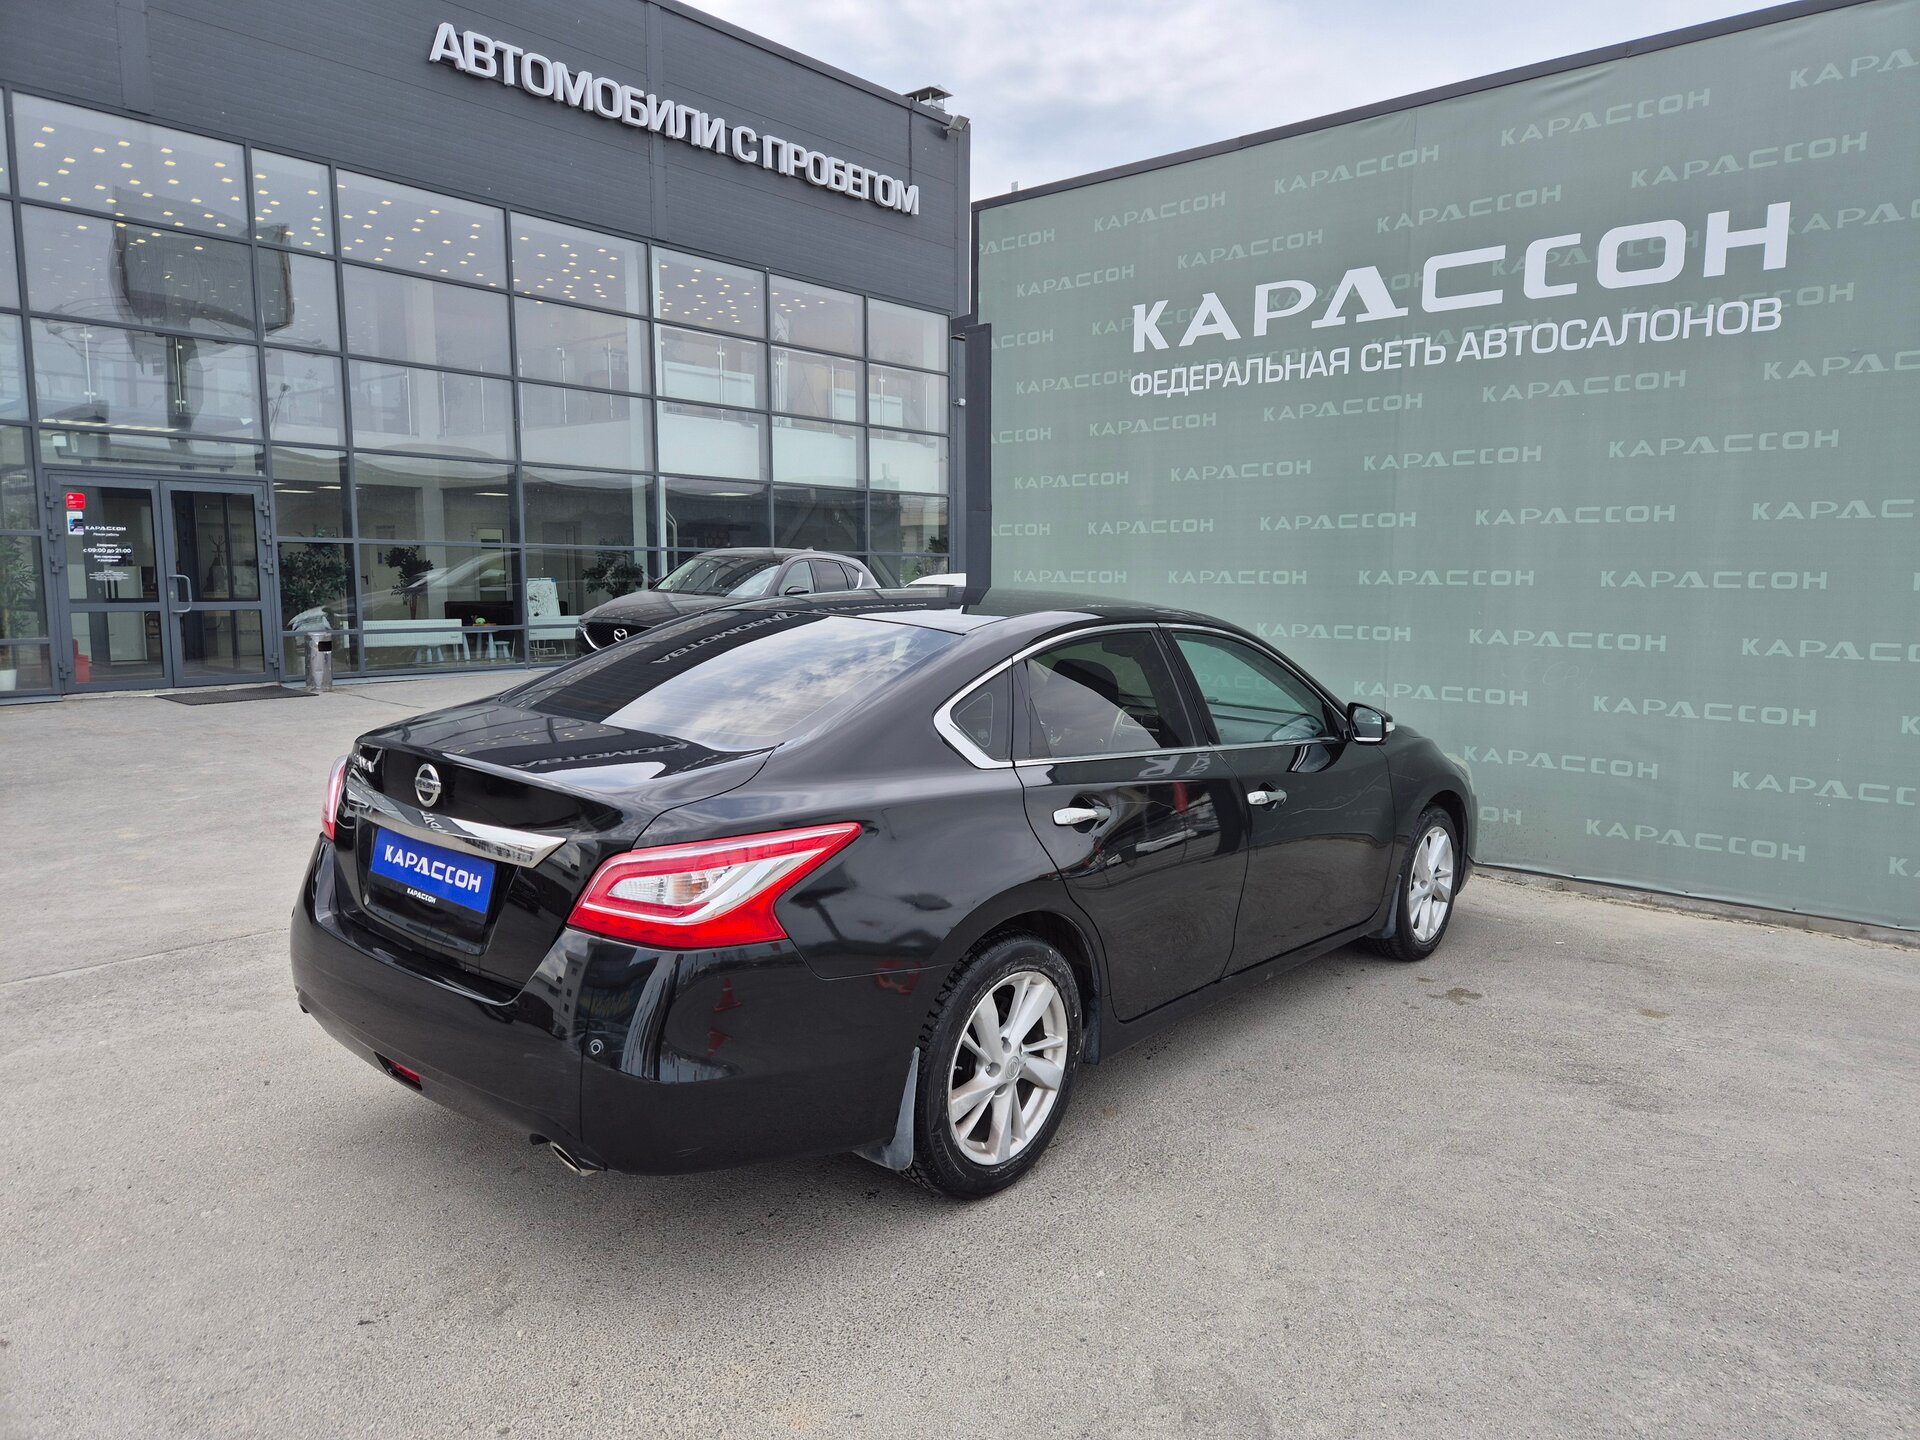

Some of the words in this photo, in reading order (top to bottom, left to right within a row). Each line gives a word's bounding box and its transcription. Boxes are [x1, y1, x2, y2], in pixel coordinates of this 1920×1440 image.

[429, 21, 726, 154] АВТОМОБИЛИ
[732, 125, 757, 164] С
[762, 134, 919, 216] ПРОБЕГОМ
[1132, 201, 1791, 353] КАРАССОН
[1130, 347, 1350, 398] ФЕДЕРАЛЬНАЯ
[1360, 336, 1447, 373] СЕТЬ
[1456, 297, 1782, 362] АВТОСАЛОНОВ
[384, 844, 482, 893] КАРАССОН
